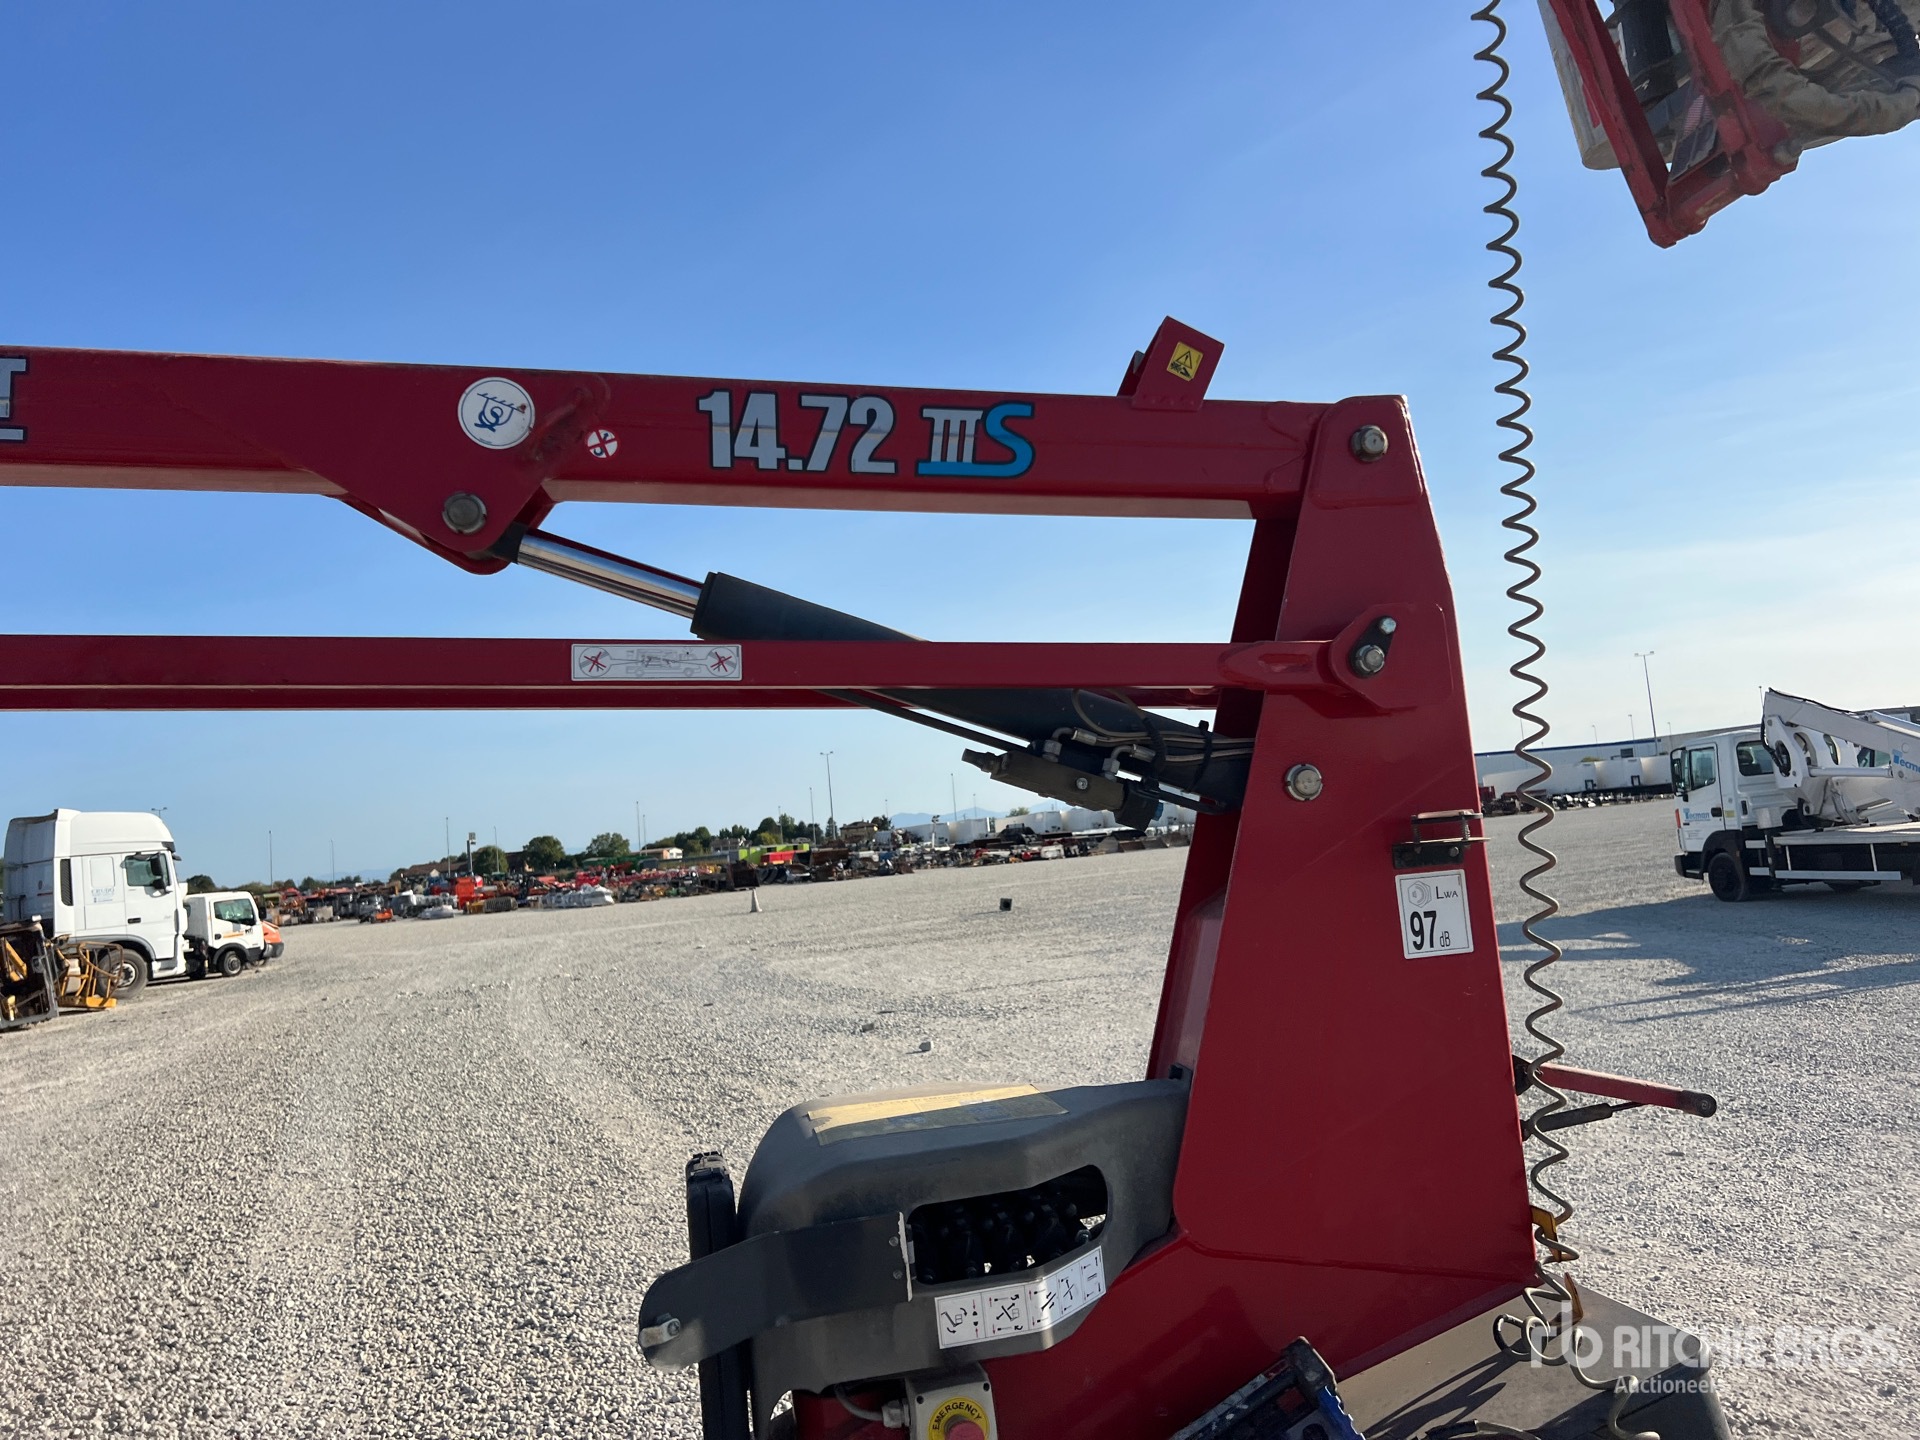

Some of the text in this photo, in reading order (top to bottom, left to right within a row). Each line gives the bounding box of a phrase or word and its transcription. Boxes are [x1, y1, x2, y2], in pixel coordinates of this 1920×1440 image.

[698, 389, 897, 474] 14.72
[1891, 749, 1920, 773] Tecm
[1410, 911, 1451, 951] 97 dB
[932, 1401, 982, 1430] EMERGENCY
